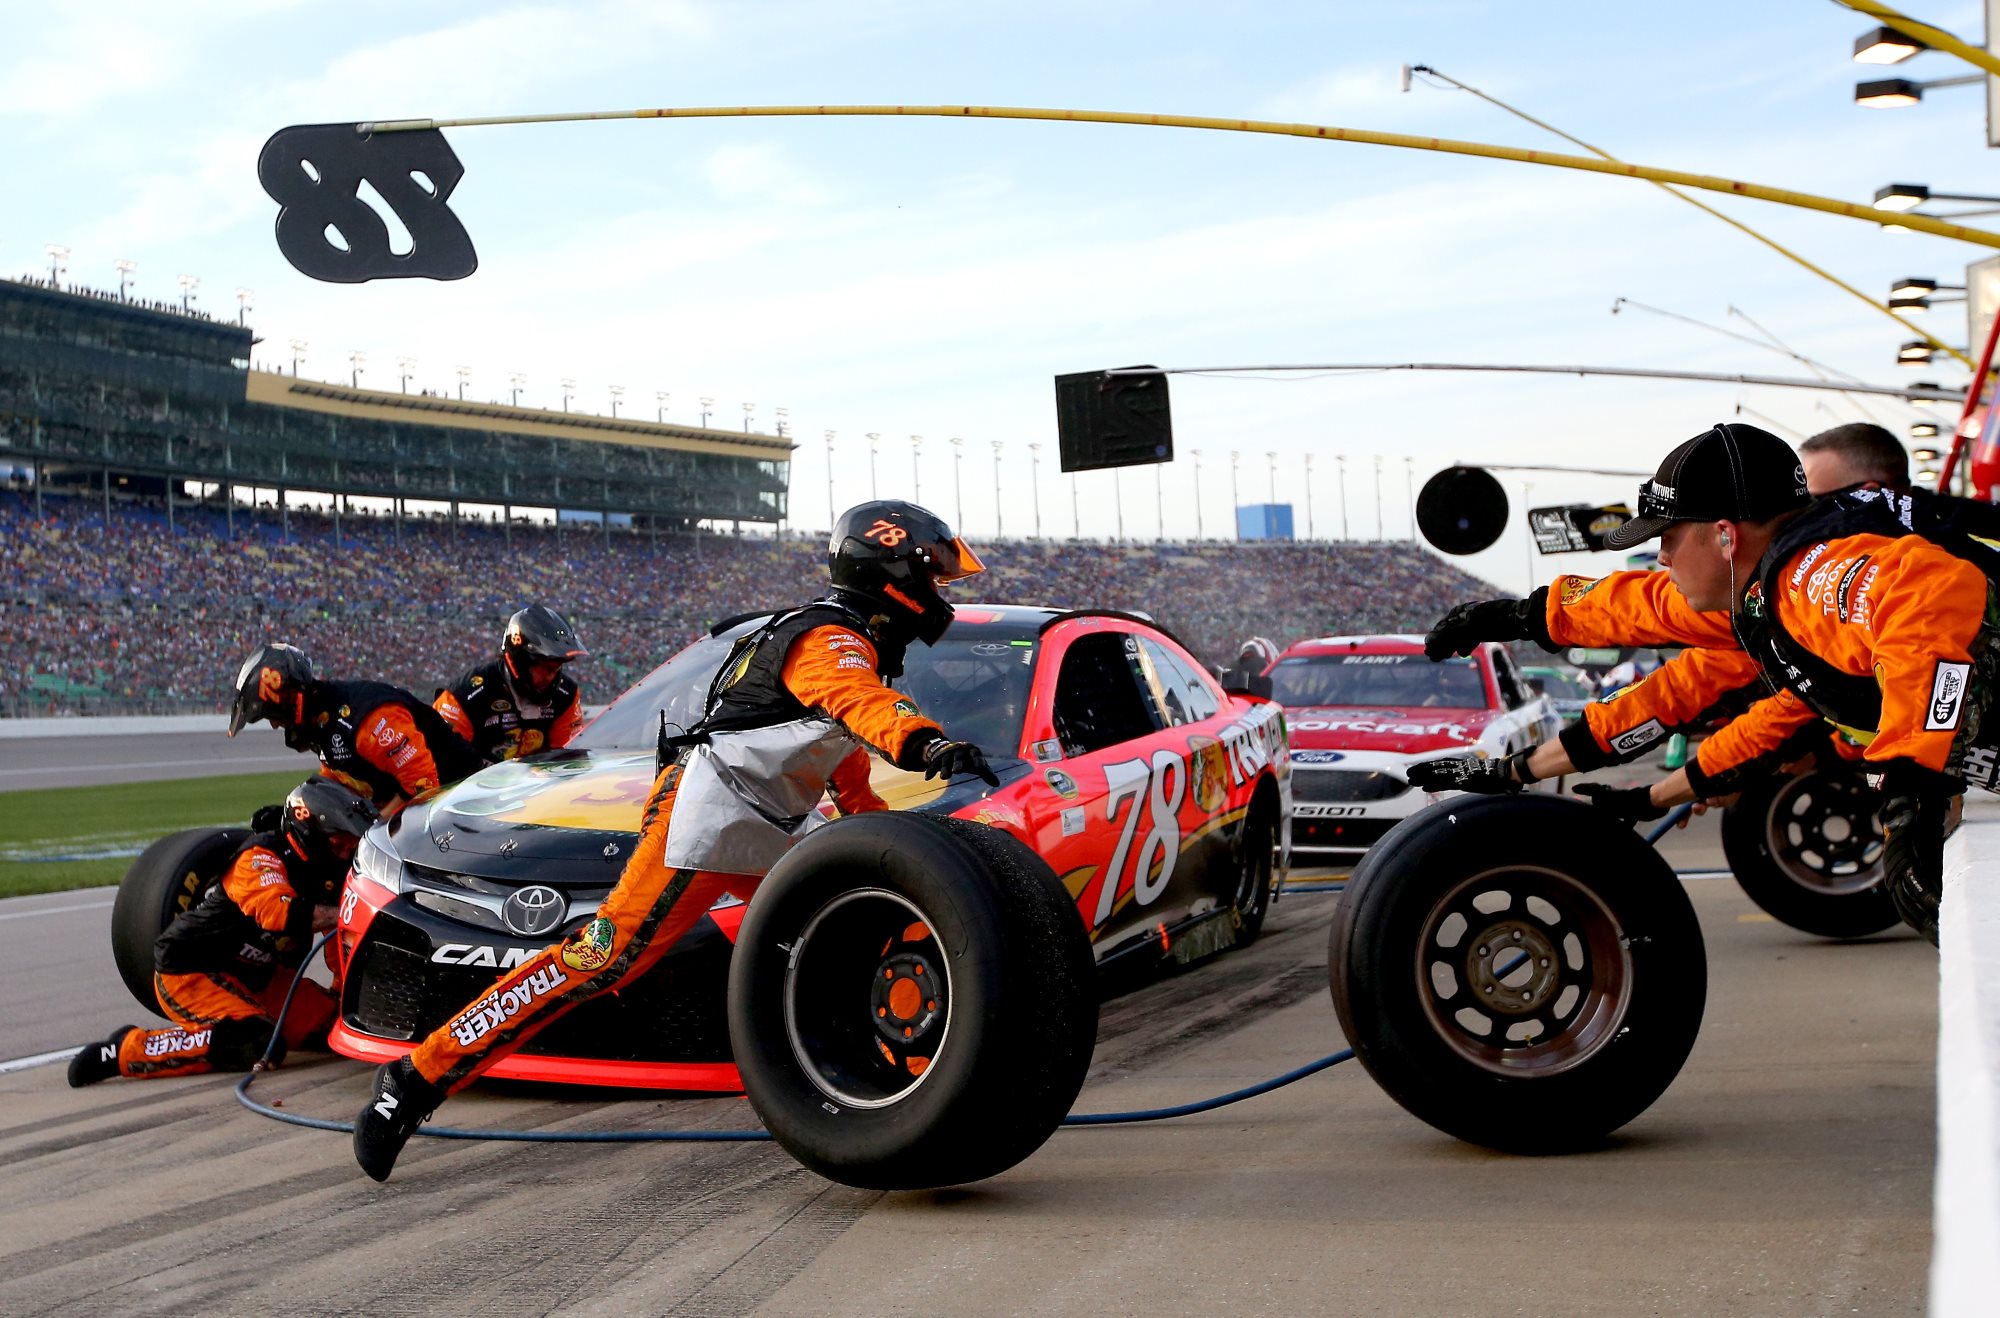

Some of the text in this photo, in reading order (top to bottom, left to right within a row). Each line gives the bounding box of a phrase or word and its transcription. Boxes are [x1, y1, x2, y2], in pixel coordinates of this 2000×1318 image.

[864, 519, 907, 548] 78
[1792, 543, 1828, 586] NASCAR
[1823, 557, 1854, 616] TOYOTA
[1342, 655, 1408, 666] BLANEY
[258, 666, 282, 704] 78
[1936, 703, 1951, 720] sfi
[1294, 751, 1338, 764] Ford
[1094, 750, 1186, 927] 78
[339, 887, 358, 925] 78
[580, 946, 597, 960] Pro
[581, 952, 606, 970] Bass
[450, 990, 499, 1028] boats
[459, 963, 568, 1047] TRACKER
